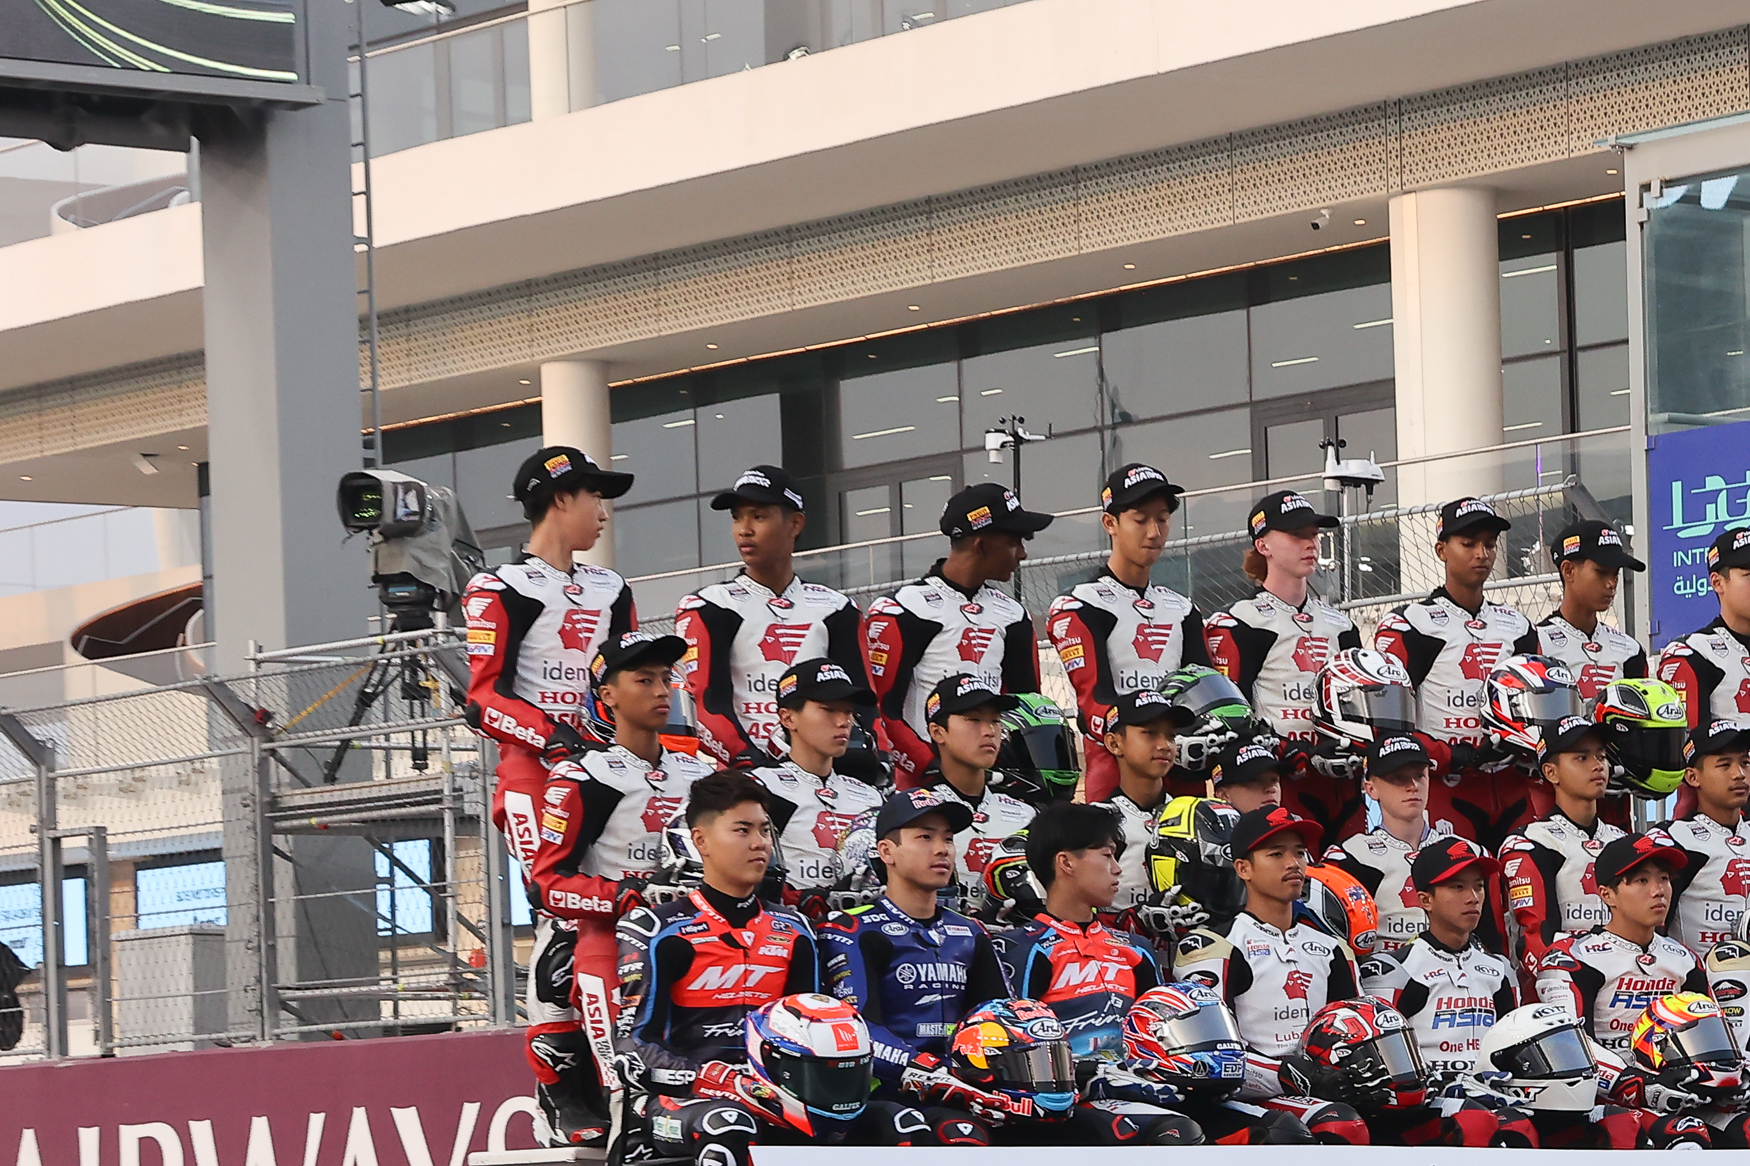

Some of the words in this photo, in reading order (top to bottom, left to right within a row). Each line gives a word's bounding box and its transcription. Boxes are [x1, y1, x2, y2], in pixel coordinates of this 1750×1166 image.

[1660, 705, 1683, 720] Arai
[499, 715, 547, 750] Beta
[1379, 742, 1400, 758] ASIA
[567, 893, 613, 913] Beta
[861, 913, 890, 924] SDG
[758, 945, 789, 957] KTM
[1307, 943, 1330, 953] Arai
[1664, 944, 1686, 957] Arai
[687, 964, 785, 990] MT
[1052, 960, 1133, 990] MT
[1616, 977, 1677, 991] Honda
[1436, 996, 1495, 1010] Honda
[586, 993, 605, 1039] ASIA
[1440, 1041, 1463, 1053] One
